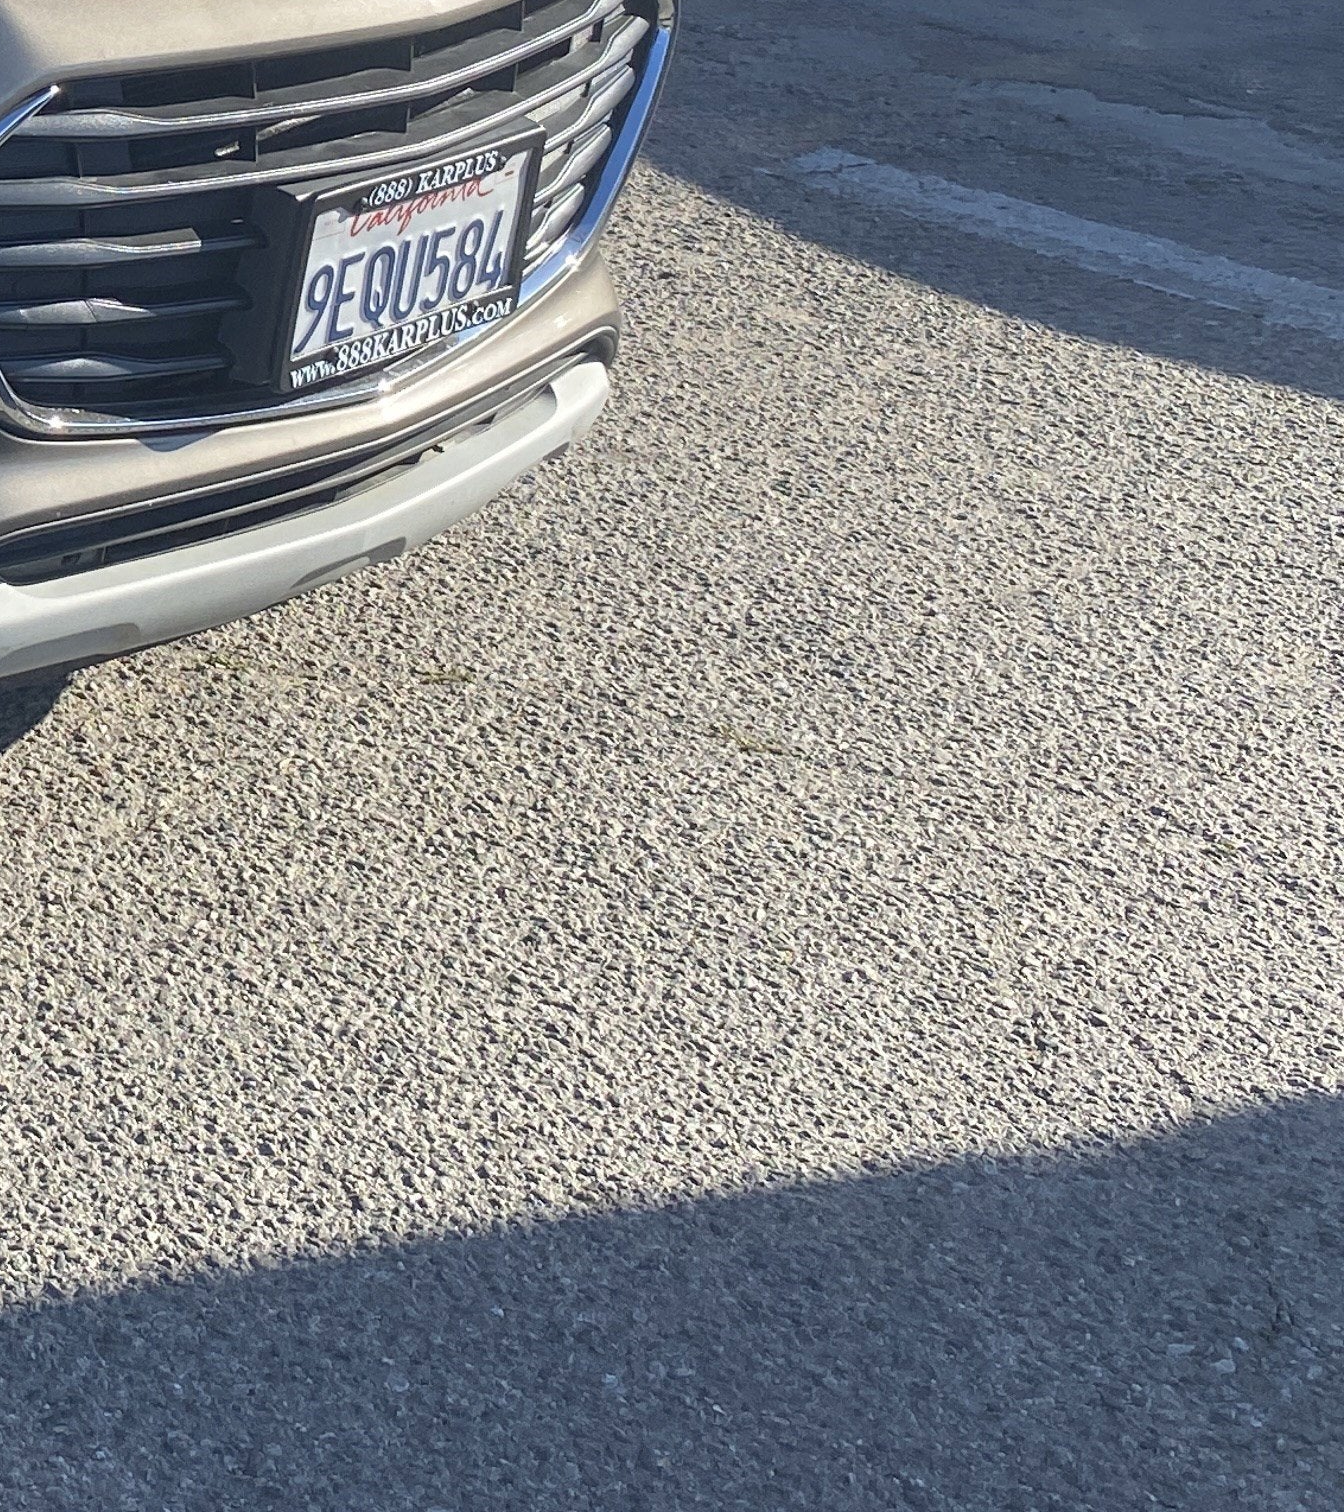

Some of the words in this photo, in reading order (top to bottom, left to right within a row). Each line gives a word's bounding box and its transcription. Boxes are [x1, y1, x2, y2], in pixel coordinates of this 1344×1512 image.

[350, 176, 495, 237] California
[368, 177, 413, 208] (888)
[414, 150, 500, 194] KARPLUS
[293, 209, 505, 355] 9EQU584
